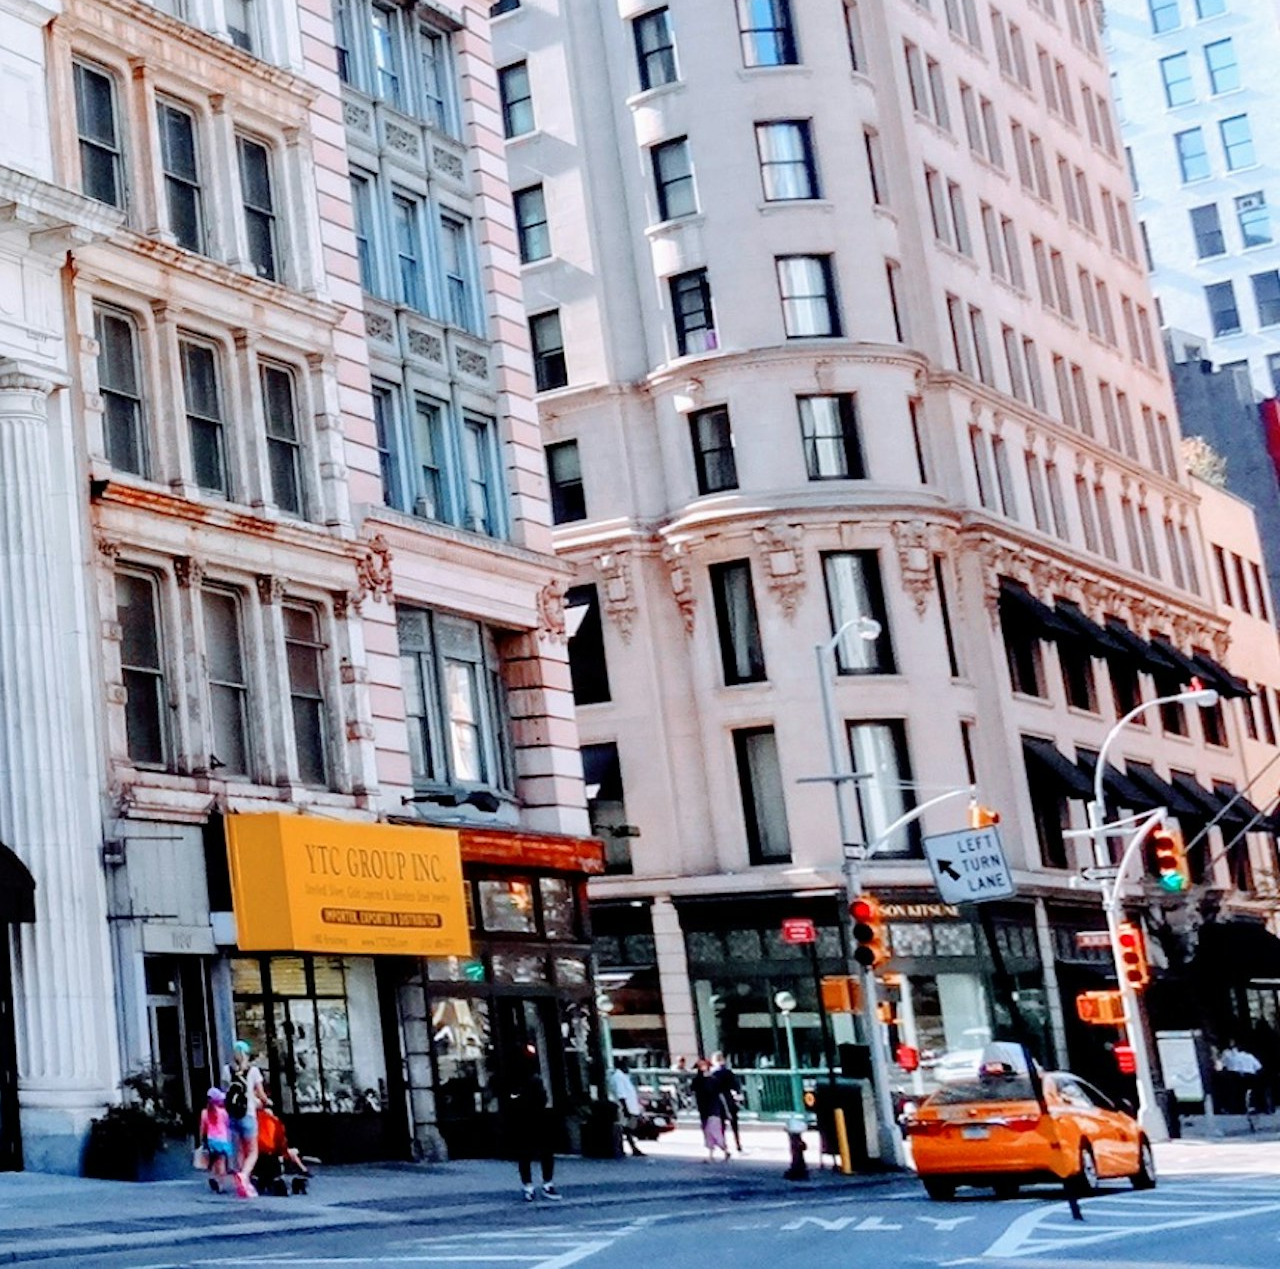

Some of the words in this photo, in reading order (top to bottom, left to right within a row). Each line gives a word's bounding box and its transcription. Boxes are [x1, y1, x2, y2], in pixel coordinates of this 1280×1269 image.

[957, 834, 992, 853] LEFT
[304, 844, 341, 877] YTC
[346, 847, 406, 881] GROUP
[411, 852, 447, 883] INC.
[961, 854, 1001, 872] TURN
[967, 872, 1007, 892] LANE
